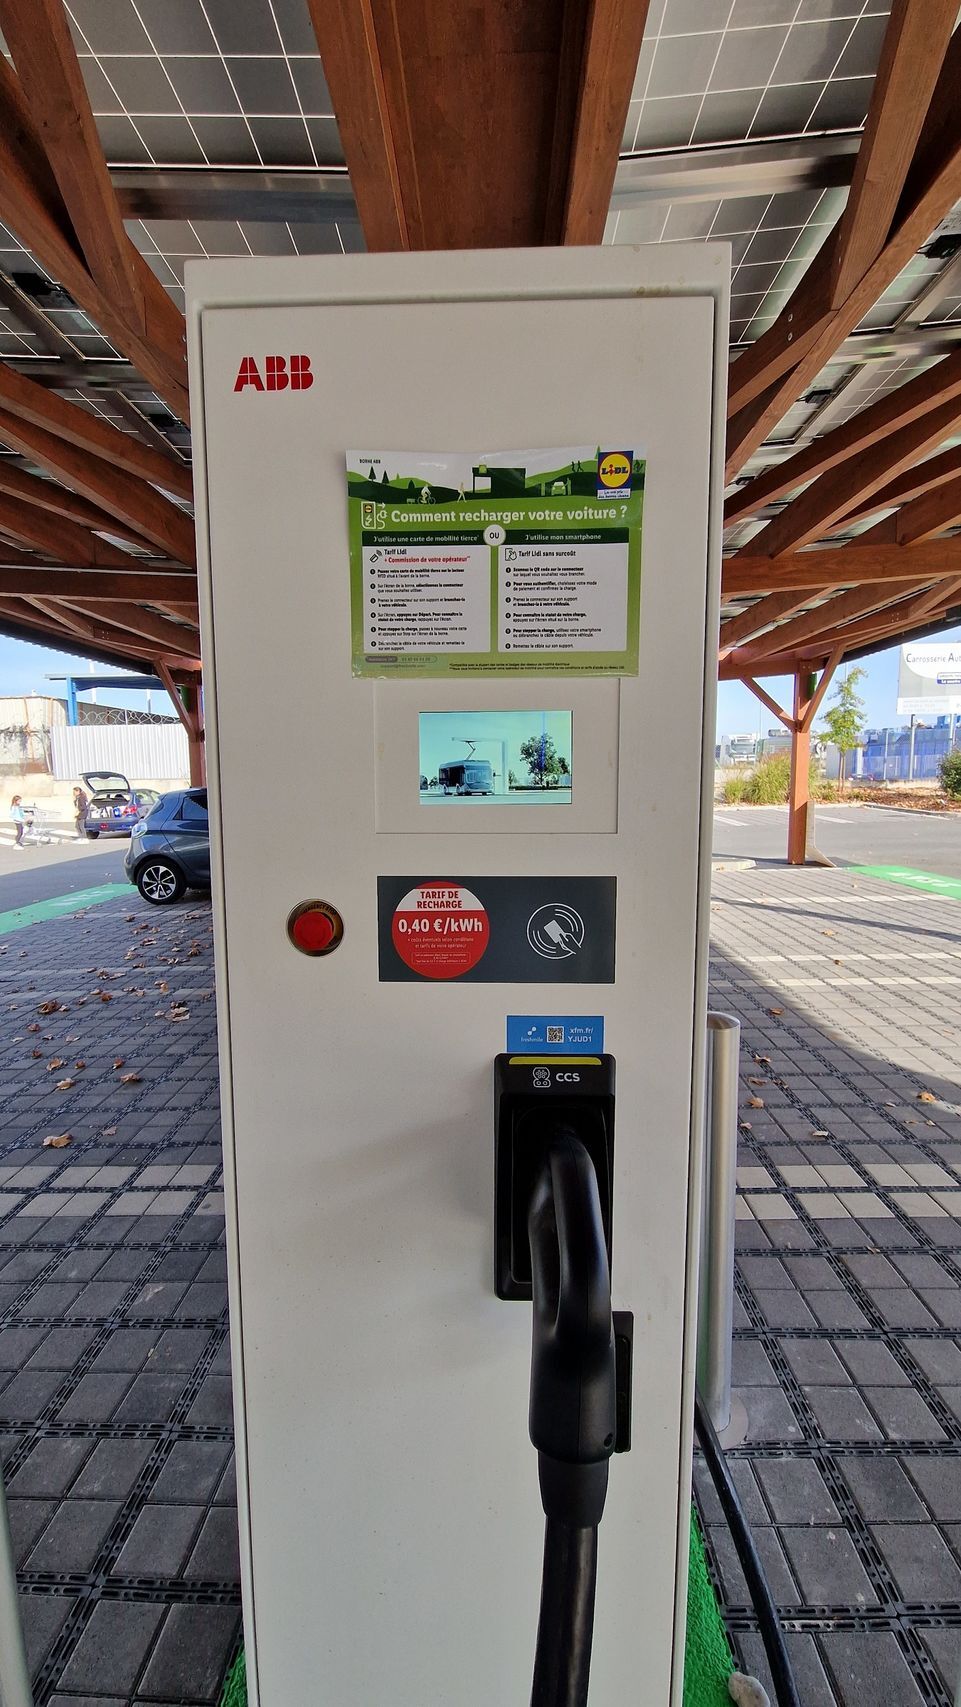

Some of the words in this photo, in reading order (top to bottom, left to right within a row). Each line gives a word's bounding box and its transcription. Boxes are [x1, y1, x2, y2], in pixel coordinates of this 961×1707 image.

[234, 355, 313, 392] ABB
[391, 510, 456, 522] Comment
[459, 509, 525, 524] recharger
[528, 510, 563, 520] votre
[567, 506, 616, 520] voiture
[620, 505, 627, 517] ?
[906, 653, 946, 663] Carrosserie
[420, 891, 446, 899] TARIF
[417, 900, 462, 909] RECHARGE
[398, 919, 429, 935] 0,40
[433, 917, 482, 934] €/kWh
[556, 1073, 580, 1082] CCS
